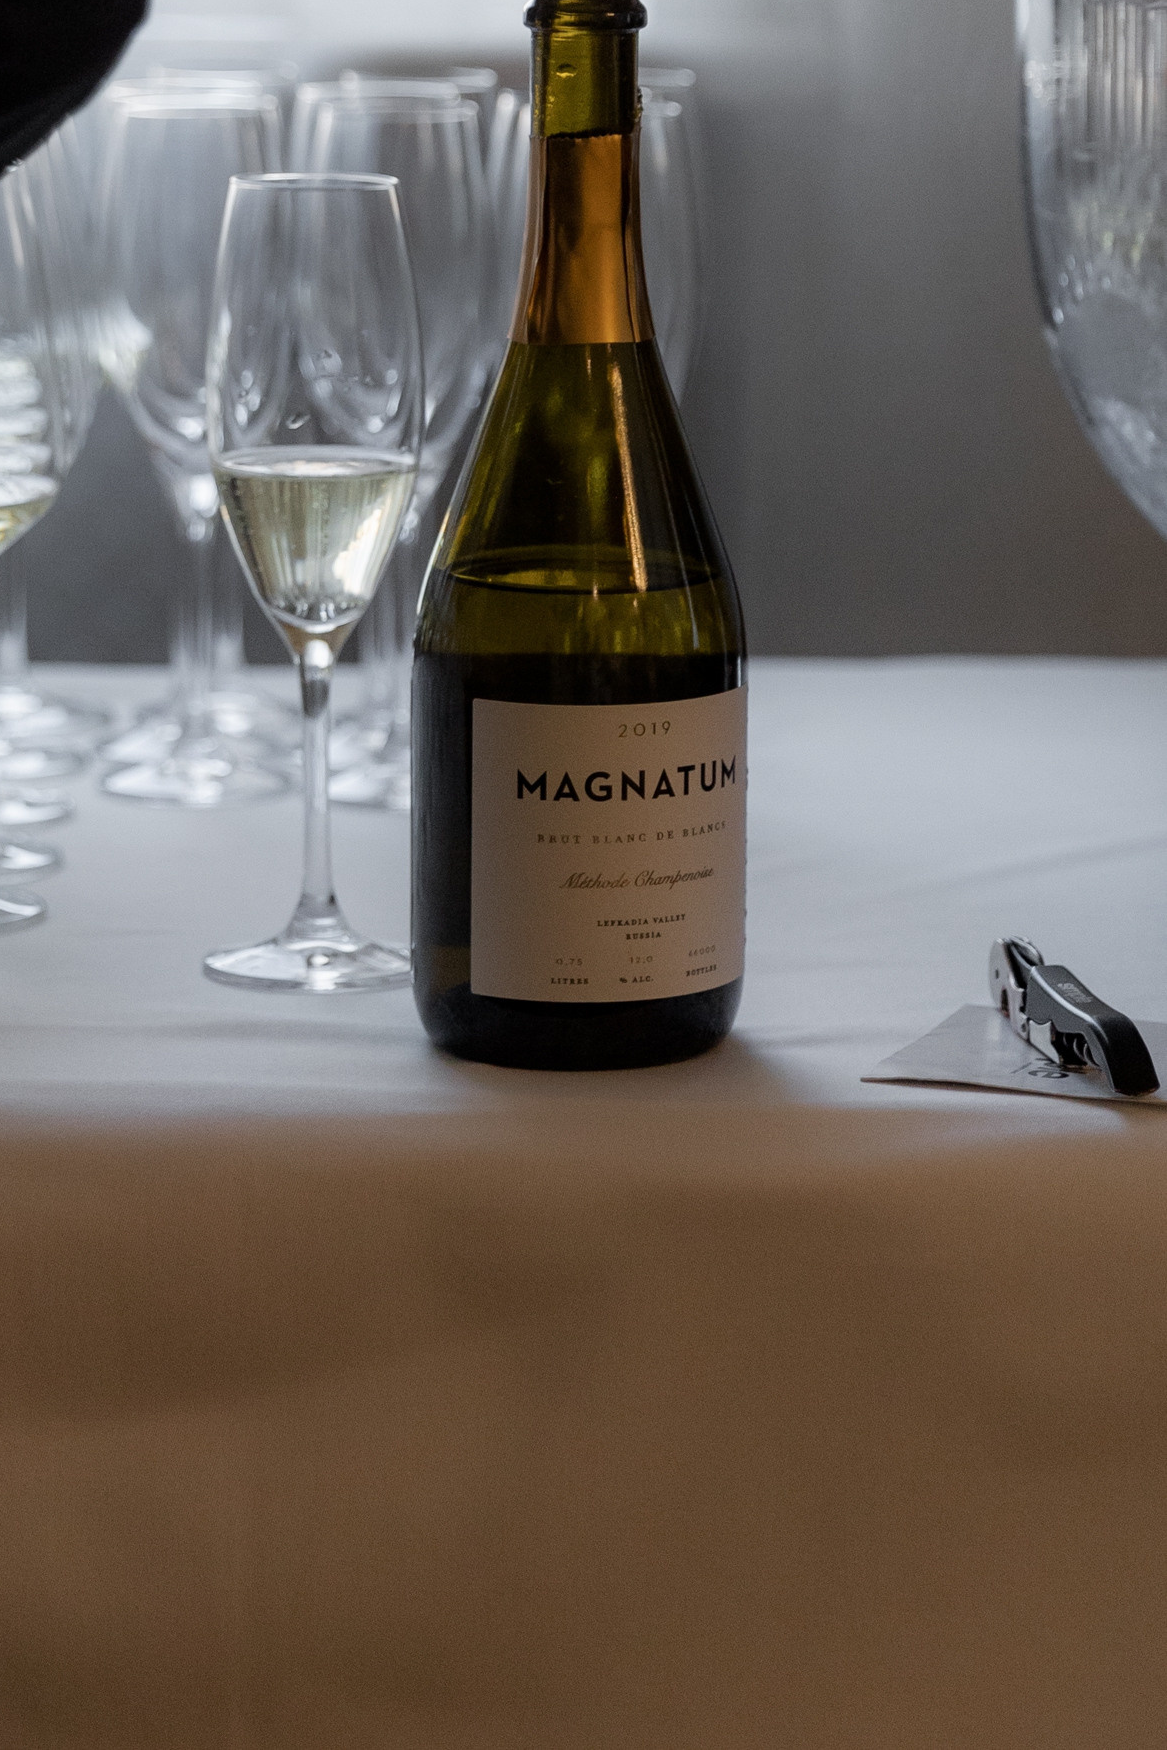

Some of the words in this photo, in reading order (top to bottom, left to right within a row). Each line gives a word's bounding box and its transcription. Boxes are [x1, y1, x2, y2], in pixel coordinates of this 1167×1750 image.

[617, 720, 672, 739] 2019
[516, 753, 737, 802] MAGNATUM
[537, 833, 581, 845] BRUT
[592, 833, 647, 844] BLANC
[656, 830, 675, 841] DE
[633, 865, 714, 890] Champenoise
[652, 913, 686, 924] VALLEY
[625, 931, 662, 940] RUSSIA
